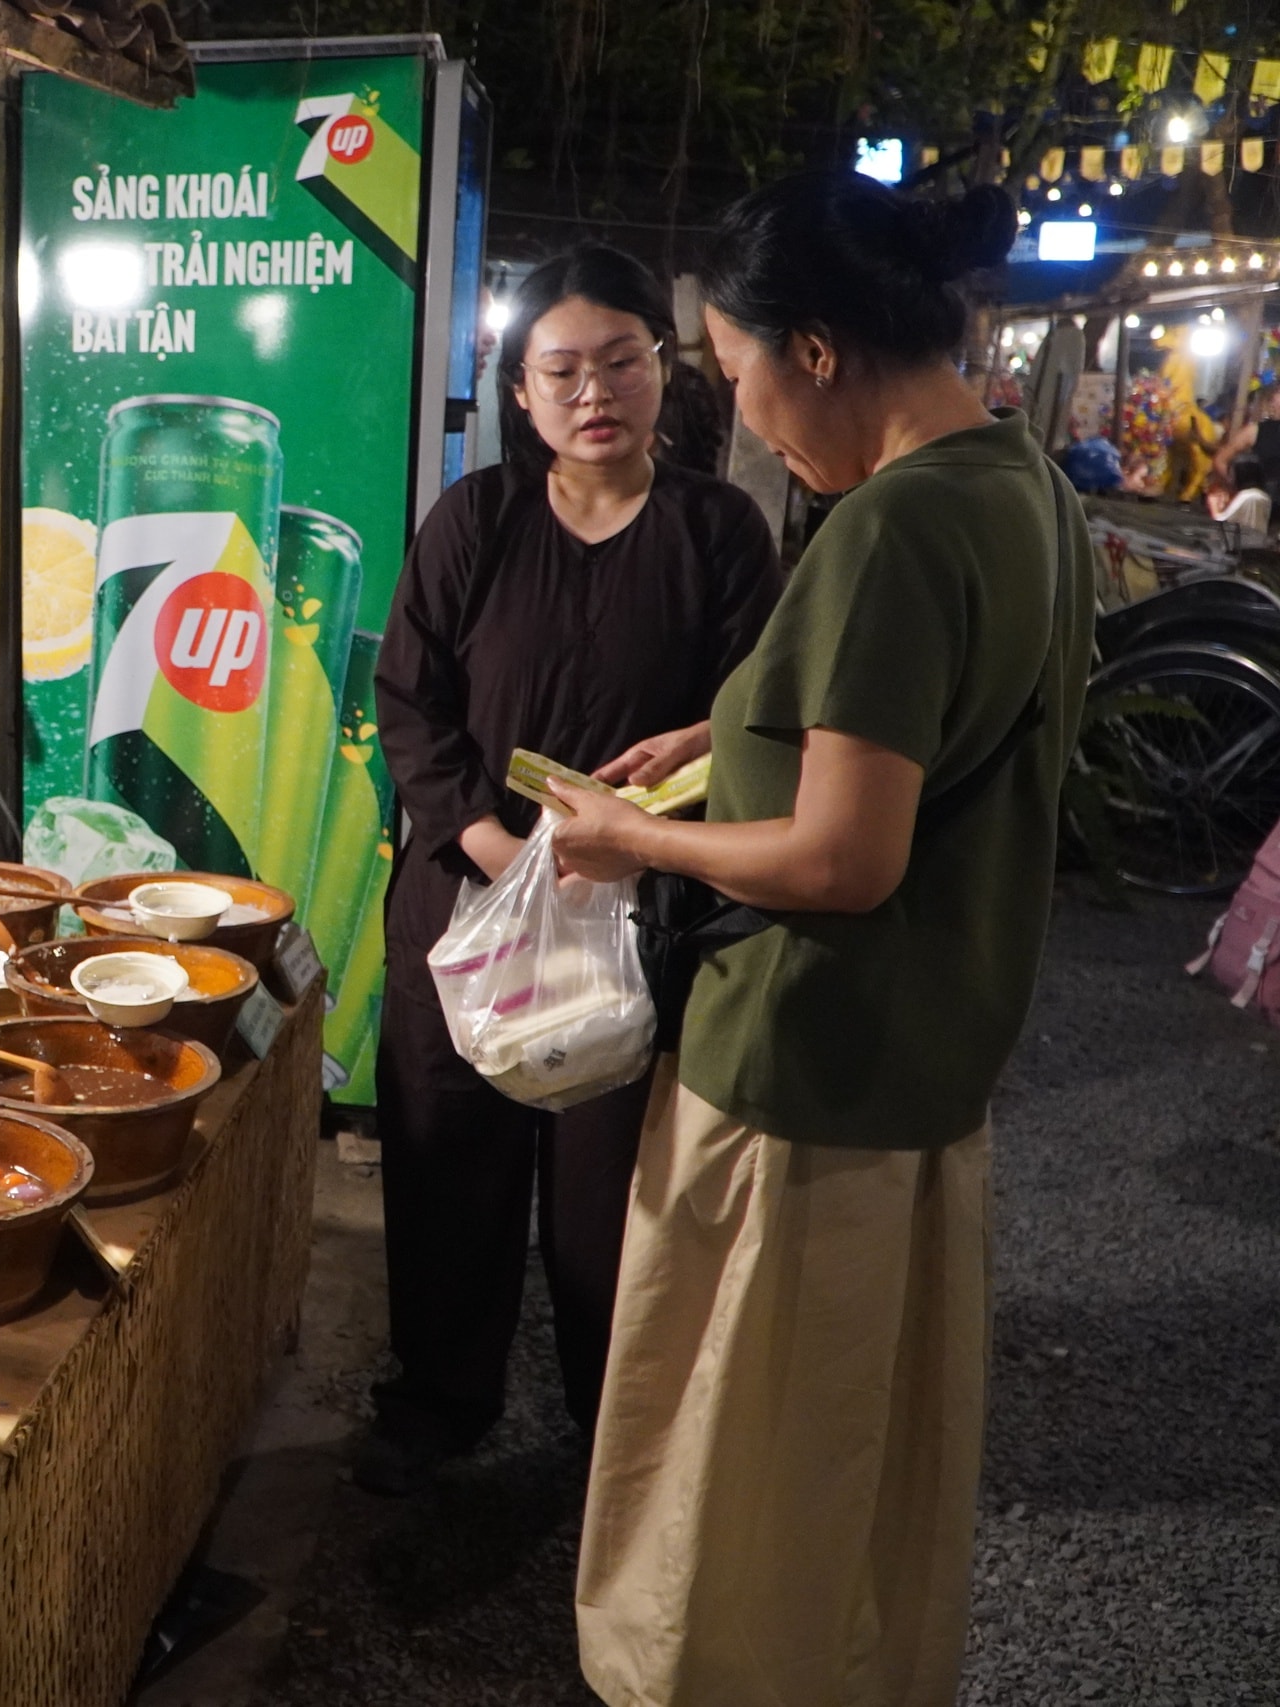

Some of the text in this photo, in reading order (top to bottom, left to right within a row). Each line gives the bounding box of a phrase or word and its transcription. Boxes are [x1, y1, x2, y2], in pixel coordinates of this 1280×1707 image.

[71, 163, 268, 221] SẢNG KHOÁI
[143, 229, 354, 295] TRẢI NGHIỆM
[134, 301, 196, 361] TẬN
